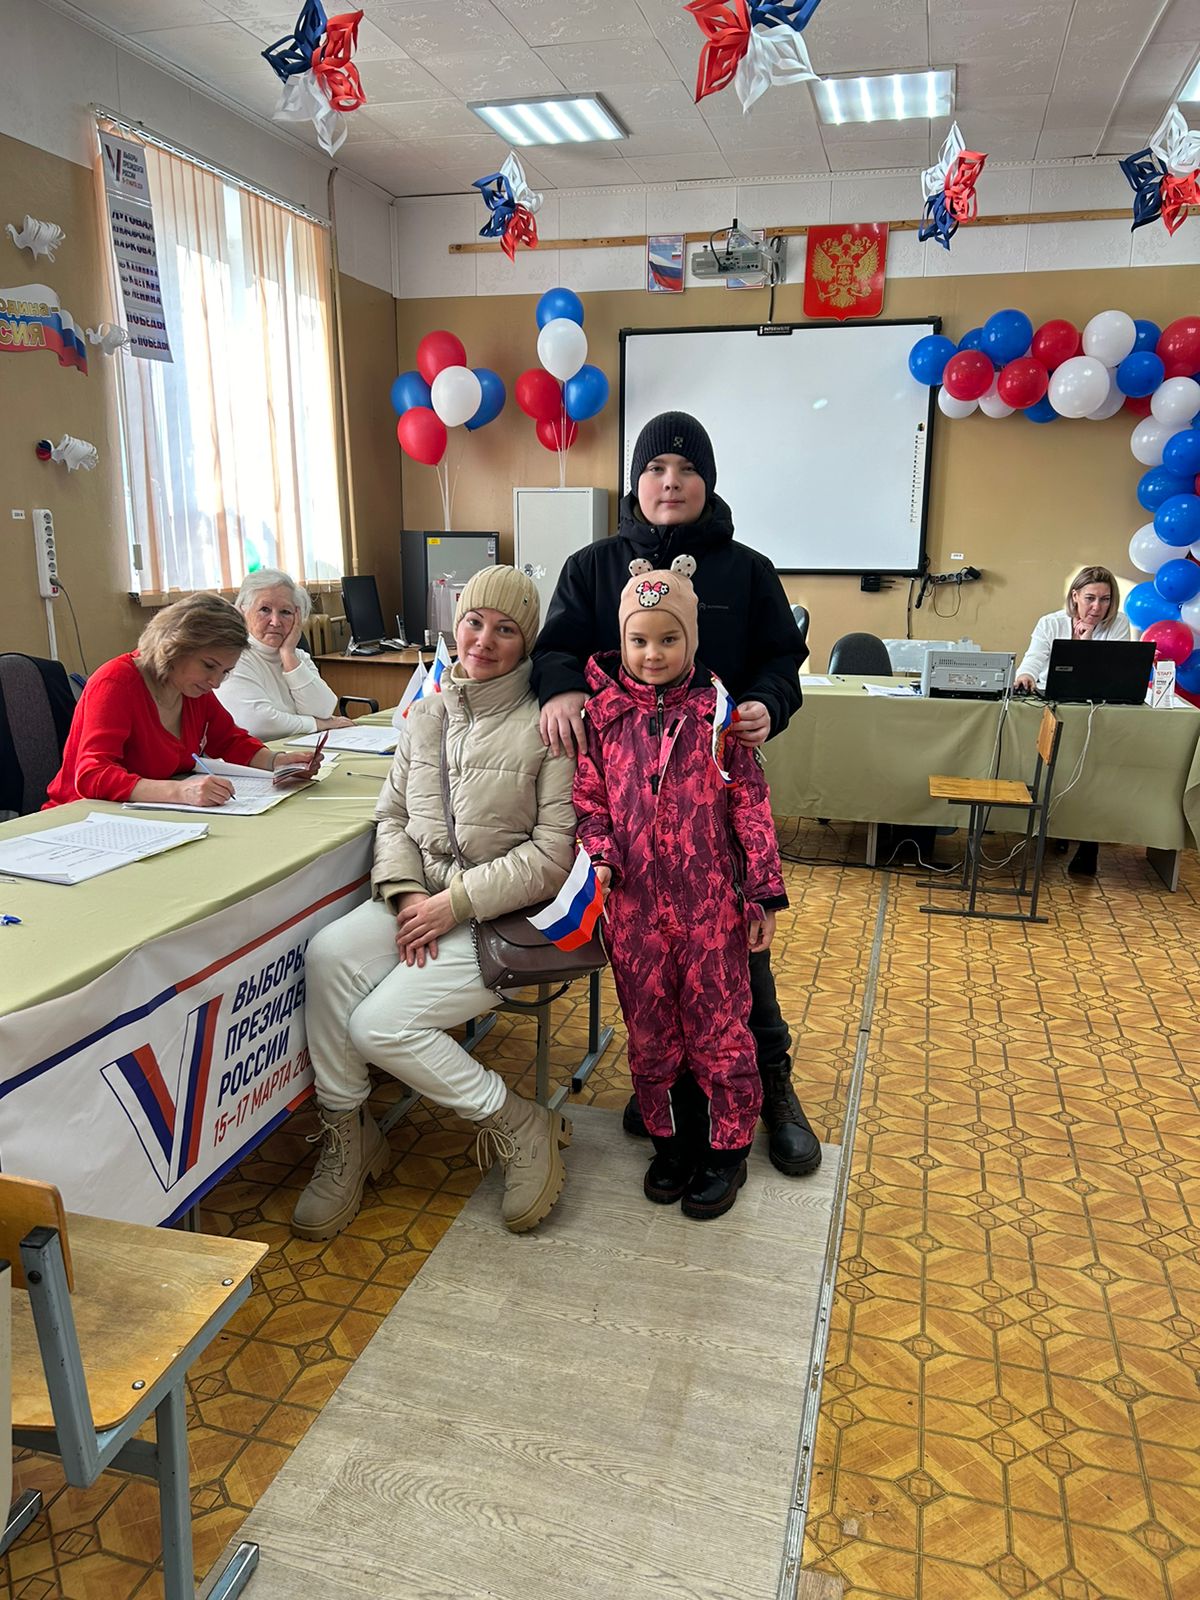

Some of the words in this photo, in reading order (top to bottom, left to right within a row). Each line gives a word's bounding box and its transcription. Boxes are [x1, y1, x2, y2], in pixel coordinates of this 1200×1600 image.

[231, 938, 309, 1015] ВЫБОРЫ
[217, 1025, 290, 1108] РОССИИ
[250, 1060, 292, 1116] МАРТА
